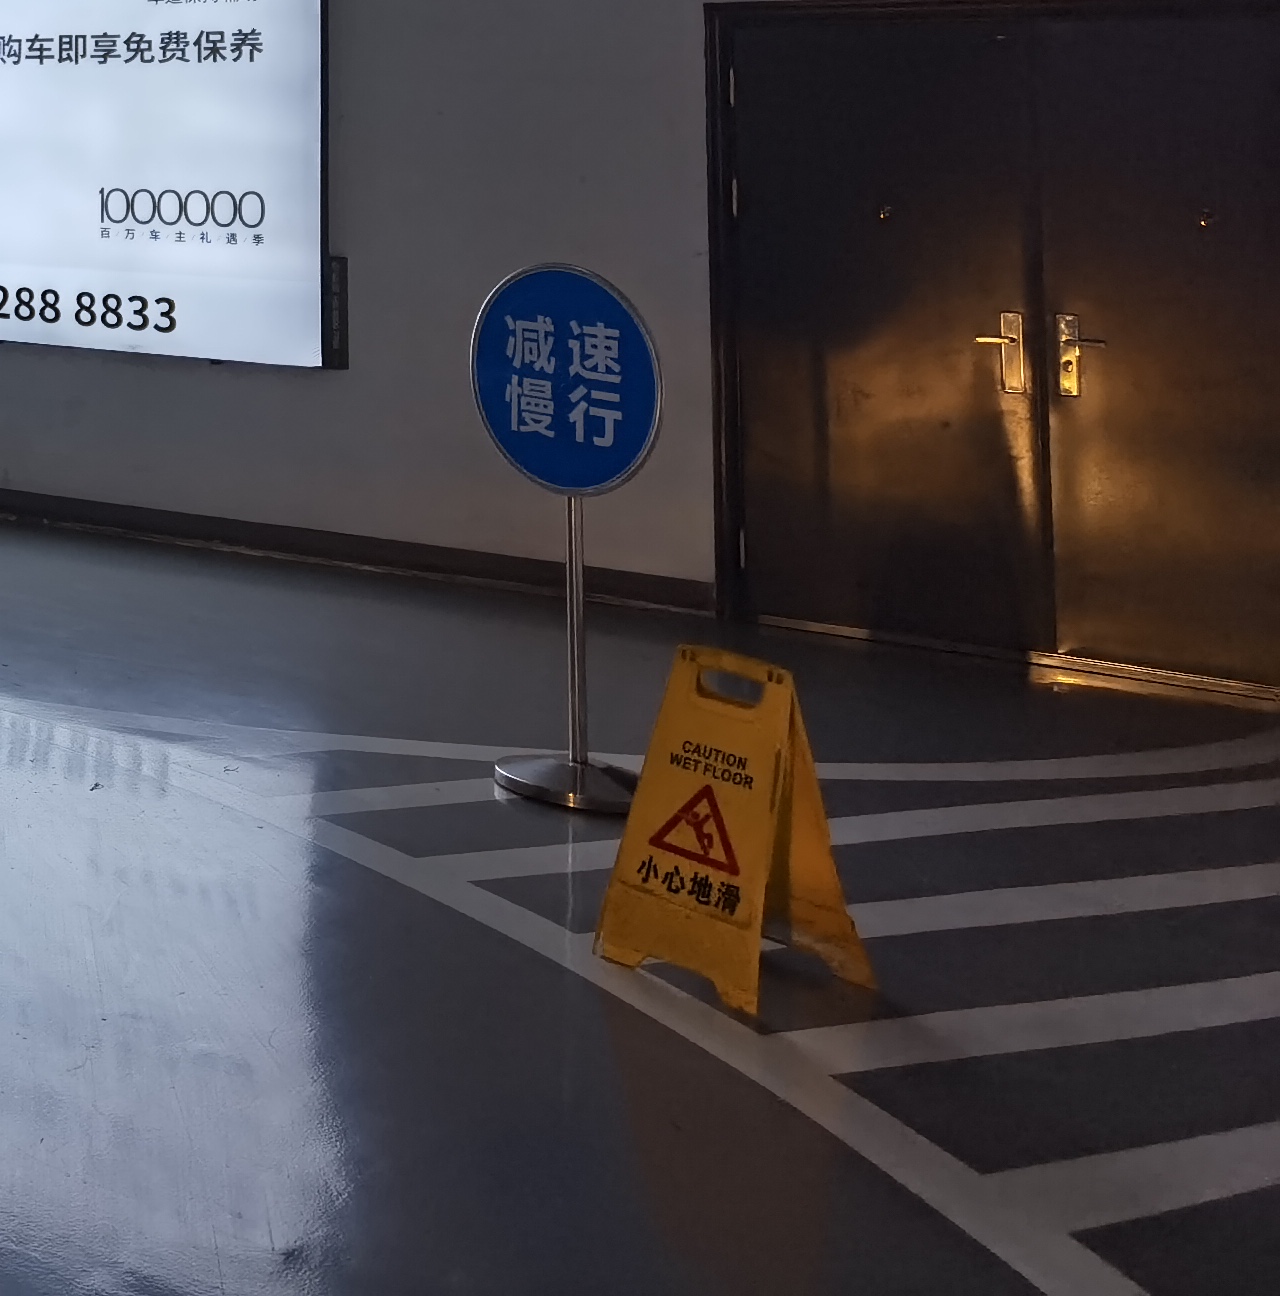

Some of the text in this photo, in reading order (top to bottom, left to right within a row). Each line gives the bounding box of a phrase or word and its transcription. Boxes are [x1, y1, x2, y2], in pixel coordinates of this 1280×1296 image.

[99, 187, 266, 229] 1000000
[74, 291, 177, 334] 8833
[504, 315, 622, 384] 减速
[505, 374, 622, 447] 慢行
[670, 752, 754, 790] WET FLOOR
[682, 740, 748, 771] CAUTION
[637, 855, 741, 916] 小心地滑
